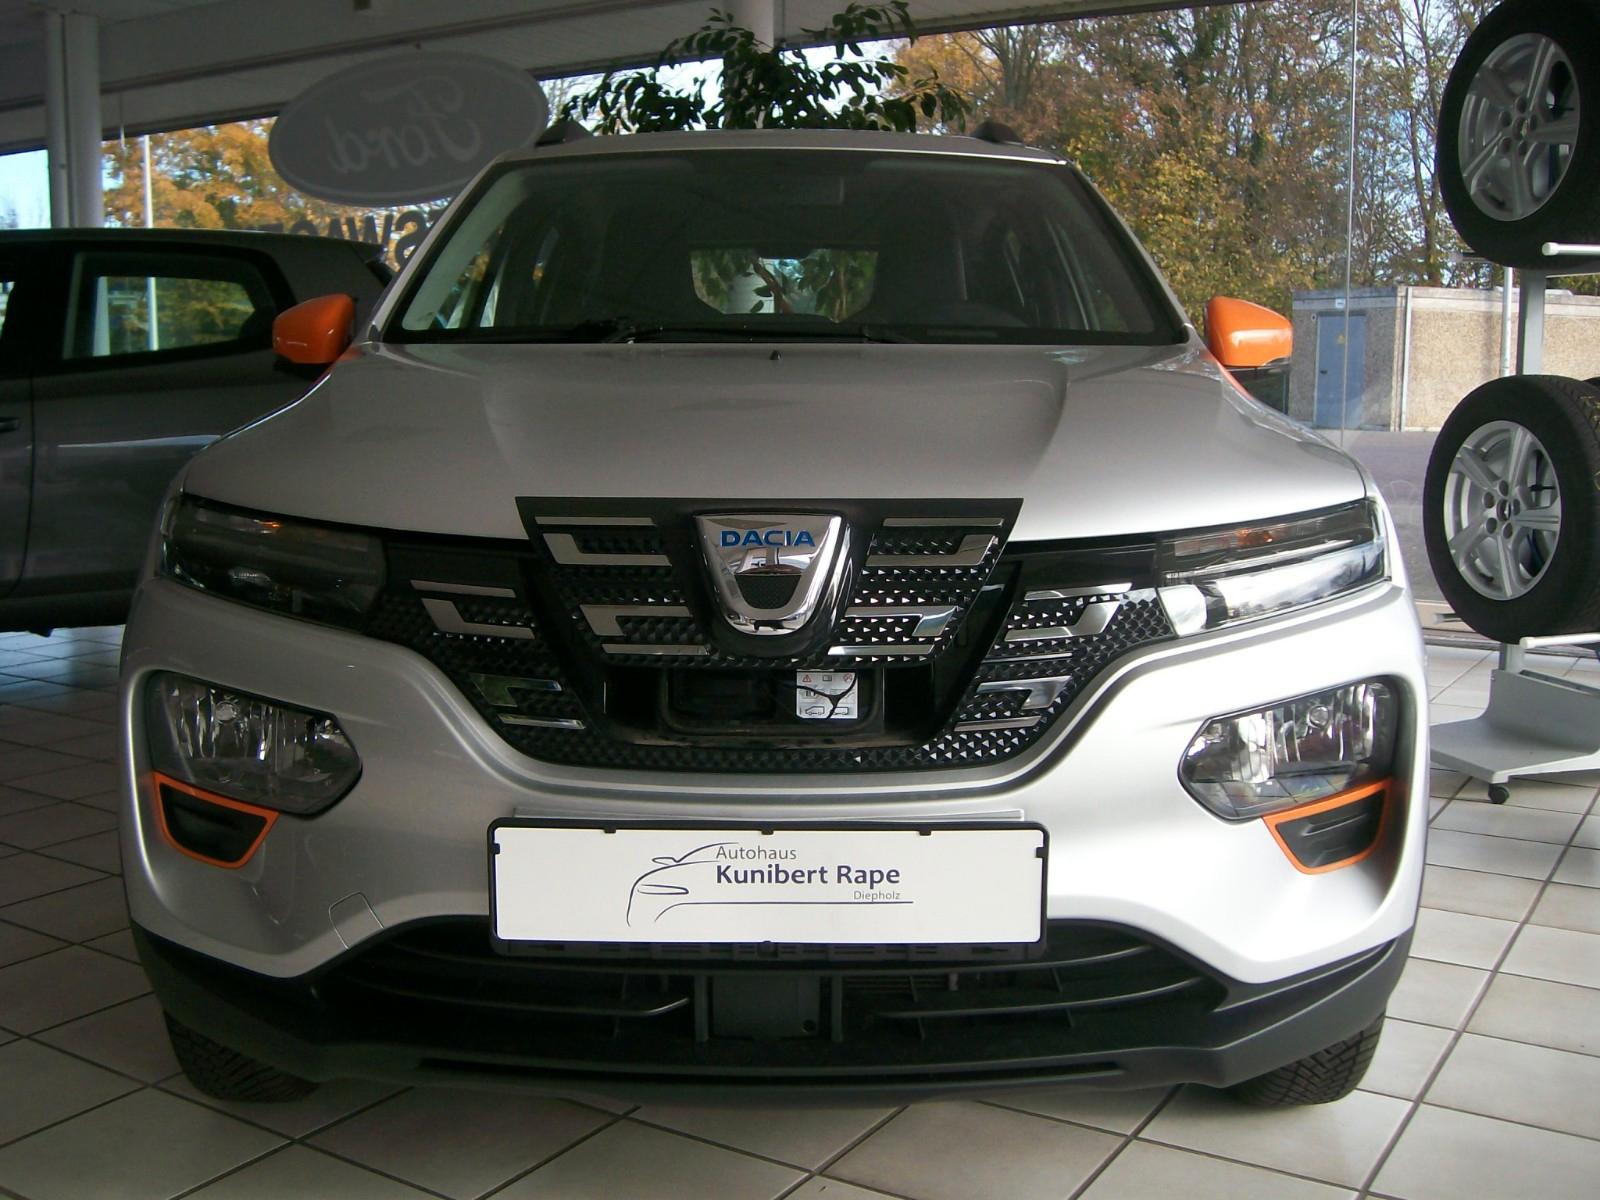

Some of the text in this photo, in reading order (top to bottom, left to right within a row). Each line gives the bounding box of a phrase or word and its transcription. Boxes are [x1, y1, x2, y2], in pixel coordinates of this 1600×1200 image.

[720, 530, 816, 547] DACIA
[716, 845, 797, 860] Autohaus
[716, 863, 901, 890] Kunibert Rape
[853, 890, 901, 903] Diepholz
